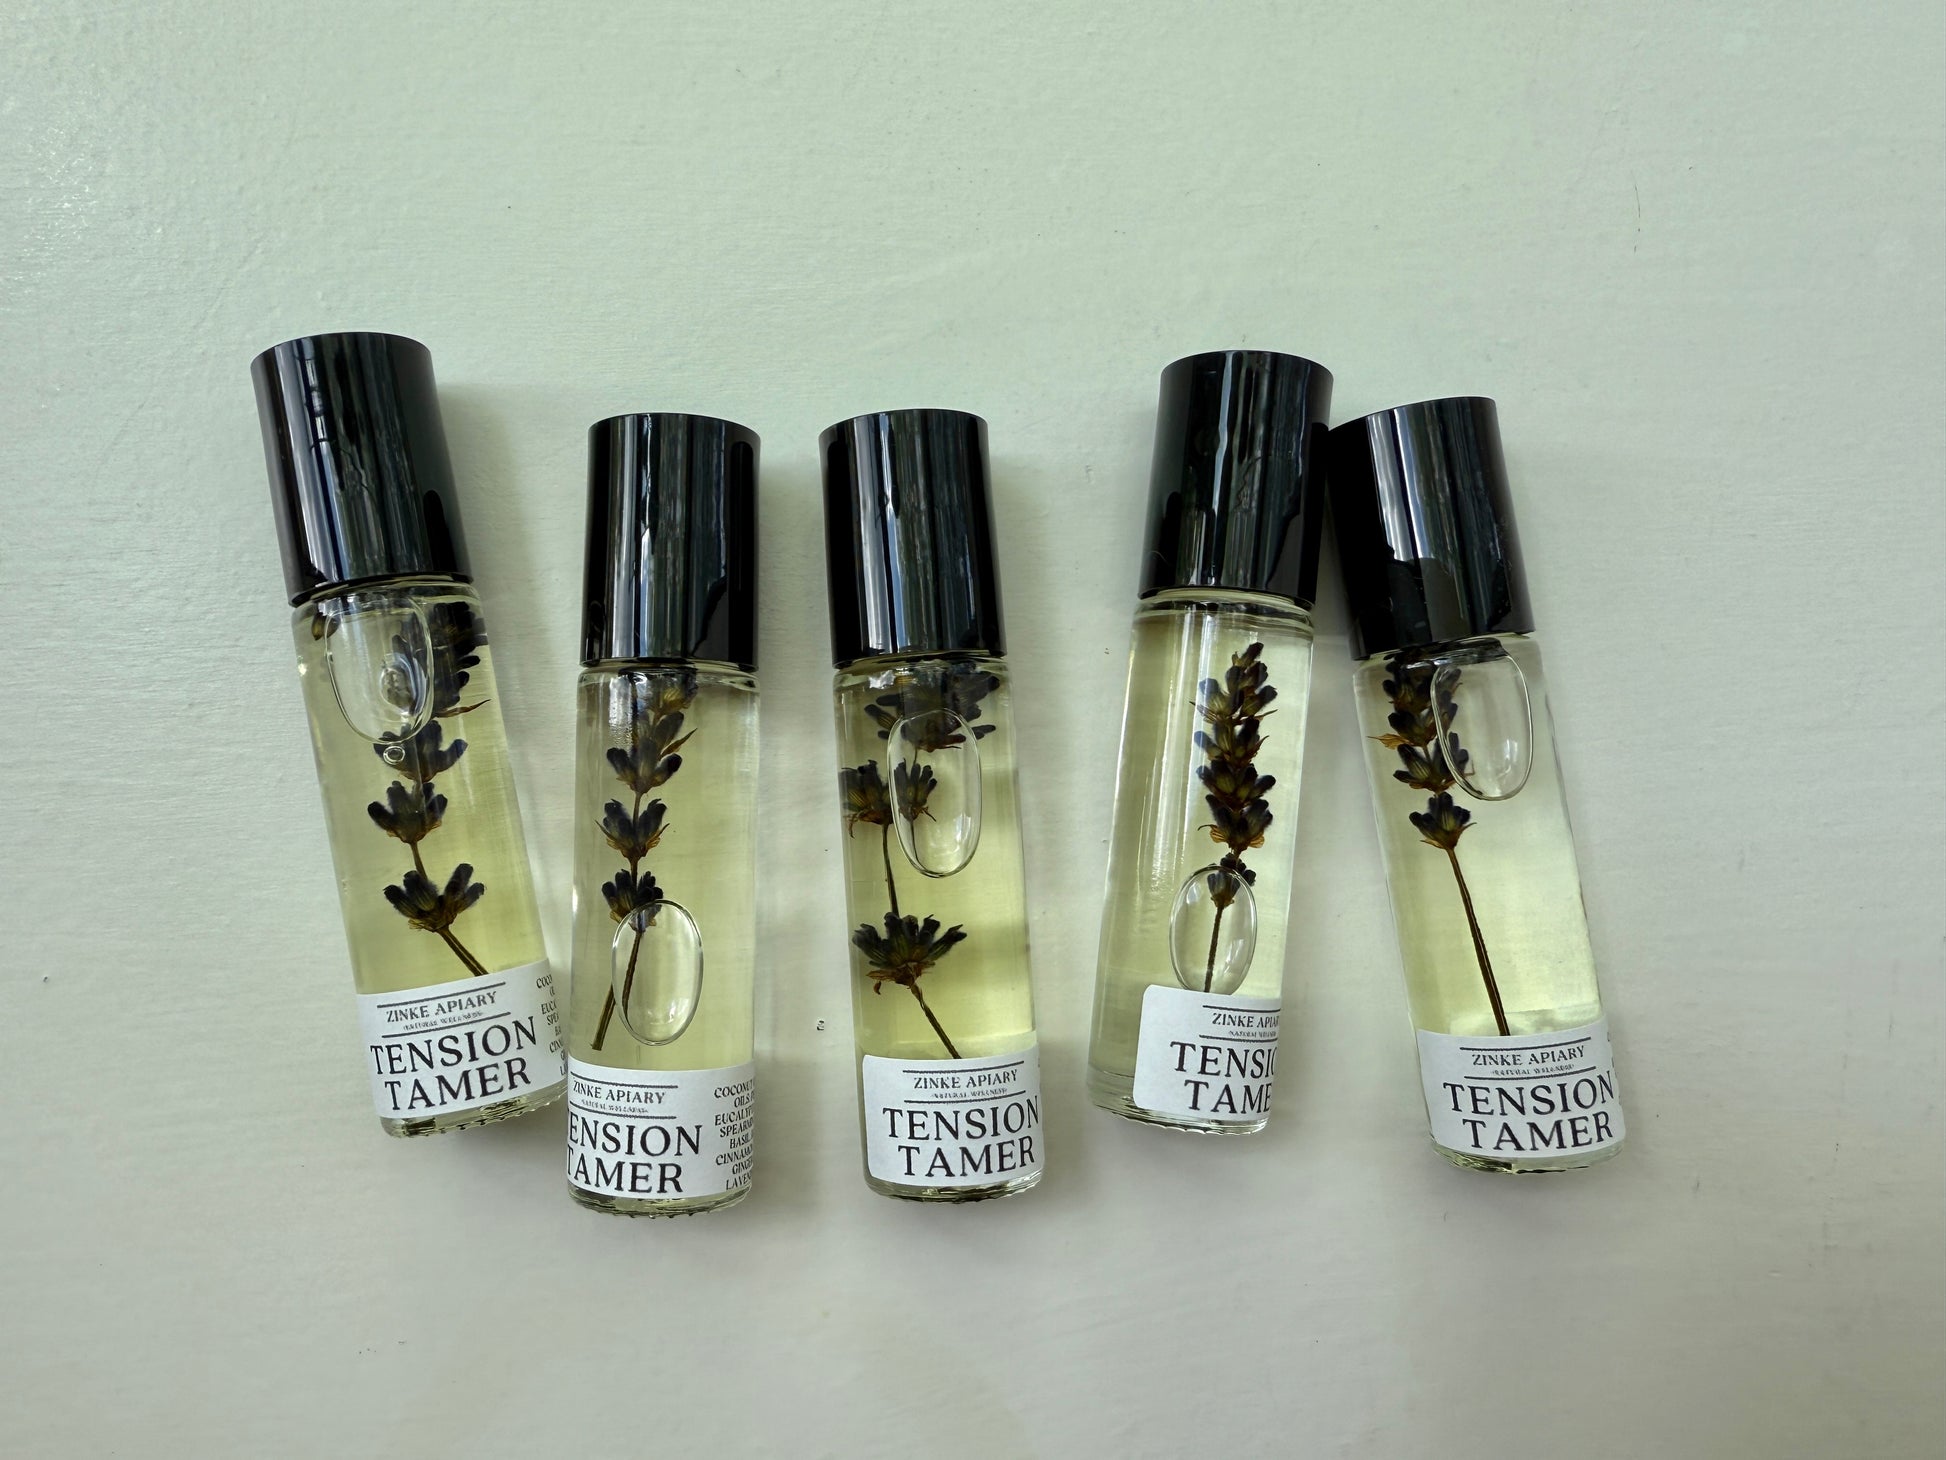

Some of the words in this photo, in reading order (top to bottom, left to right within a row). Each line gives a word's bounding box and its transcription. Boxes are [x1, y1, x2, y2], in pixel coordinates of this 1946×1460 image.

[386, 1005, 429, 1023] ZINKE
[434, 991, 497, 1016] APIARY
[1212, 1012, 1255, 1028] ZINKE
[370, 1016, 537, 1074] TENSION
[1472, 1053, 1523, 1066] ZINKE
[1528, 1045, 1586, 1065] APIARY
[384, 1057, 531, 1111] TAMER
[573, 1081, 602, 1099] ZINKE
[605, 1089, 665, 1105] APIARY
[913, 1076, 961, 1089] ZINKE
[966, 1068, 1018, 1088] APIARY
[1443, 1070, 1615, 1116] TENSION
[568, 1108, 703, 1157] ENSION
[882, 1095, 1039, 1141] TENSION
[1462, 1110, 1614, 1151] TAMER
[567, 1144, 683, 1194] TAMER
[898, 1135, 1035, 1177] TAMER
